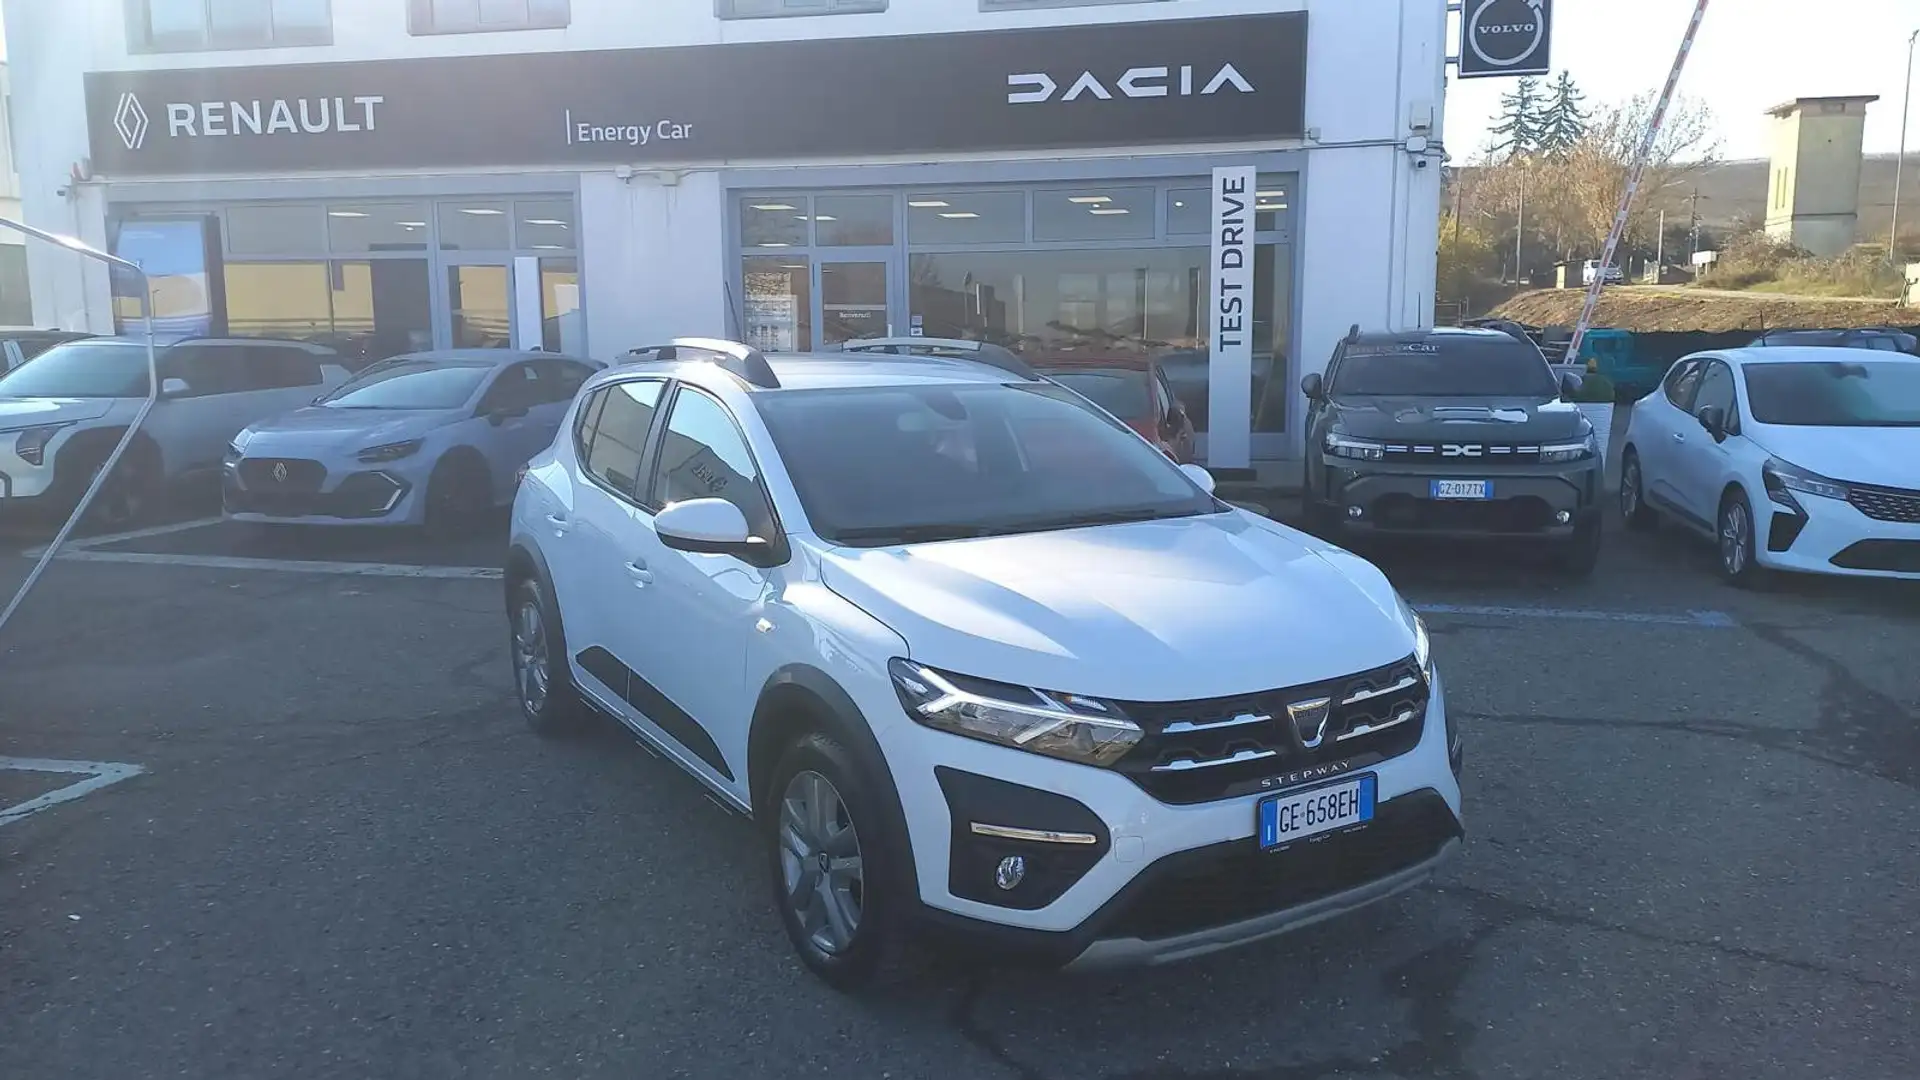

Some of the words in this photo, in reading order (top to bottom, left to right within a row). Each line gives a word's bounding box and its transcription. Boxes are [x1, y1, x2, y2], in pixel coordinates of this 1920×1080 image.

[1479, 23, 1535, 34] VOLVO
[1007, 62, 1255, 104] DACIA
[166, 95, 384, 137] RENAULT
[577, 122, 652, 146] Energy
[657, 119, 693, 140] Car
[1221, 176, 1246, 270] DRIVE
[1219, 277, 1243, 352] TEST
[1261, 759, 1351, 788] STEPWAY
